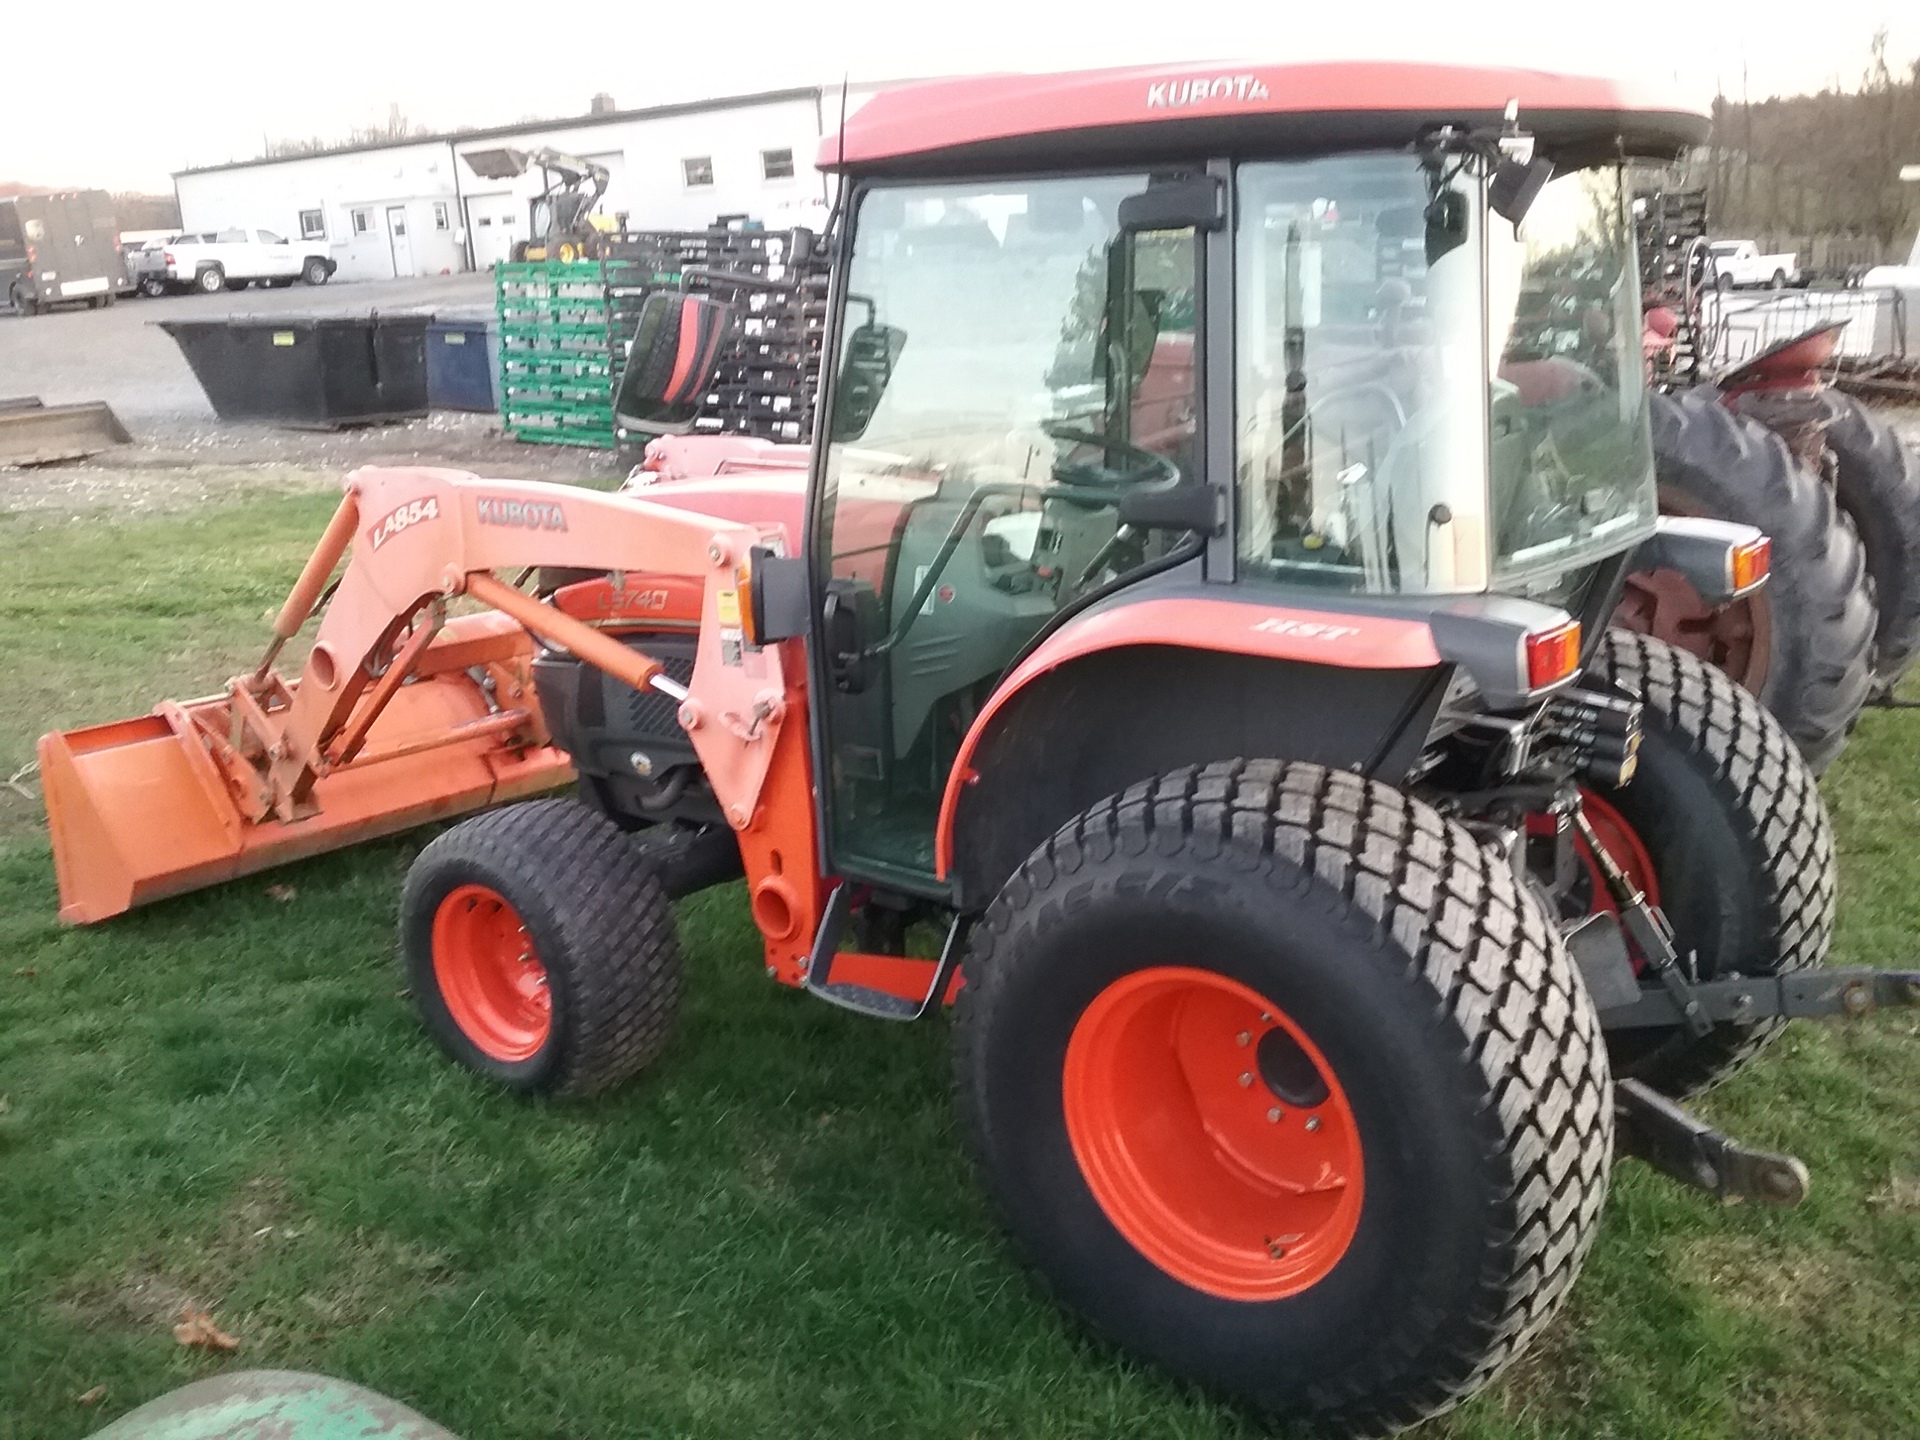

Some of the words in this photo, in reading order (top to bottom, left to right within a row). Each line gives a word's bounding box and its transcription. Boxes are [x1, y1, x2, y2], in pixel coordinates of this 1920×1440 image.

[1146, 75, 1270, 109] KUBOTA
[373, 497, 439, 551] LA854
[477, 496, 569, 533] KUBOTA
